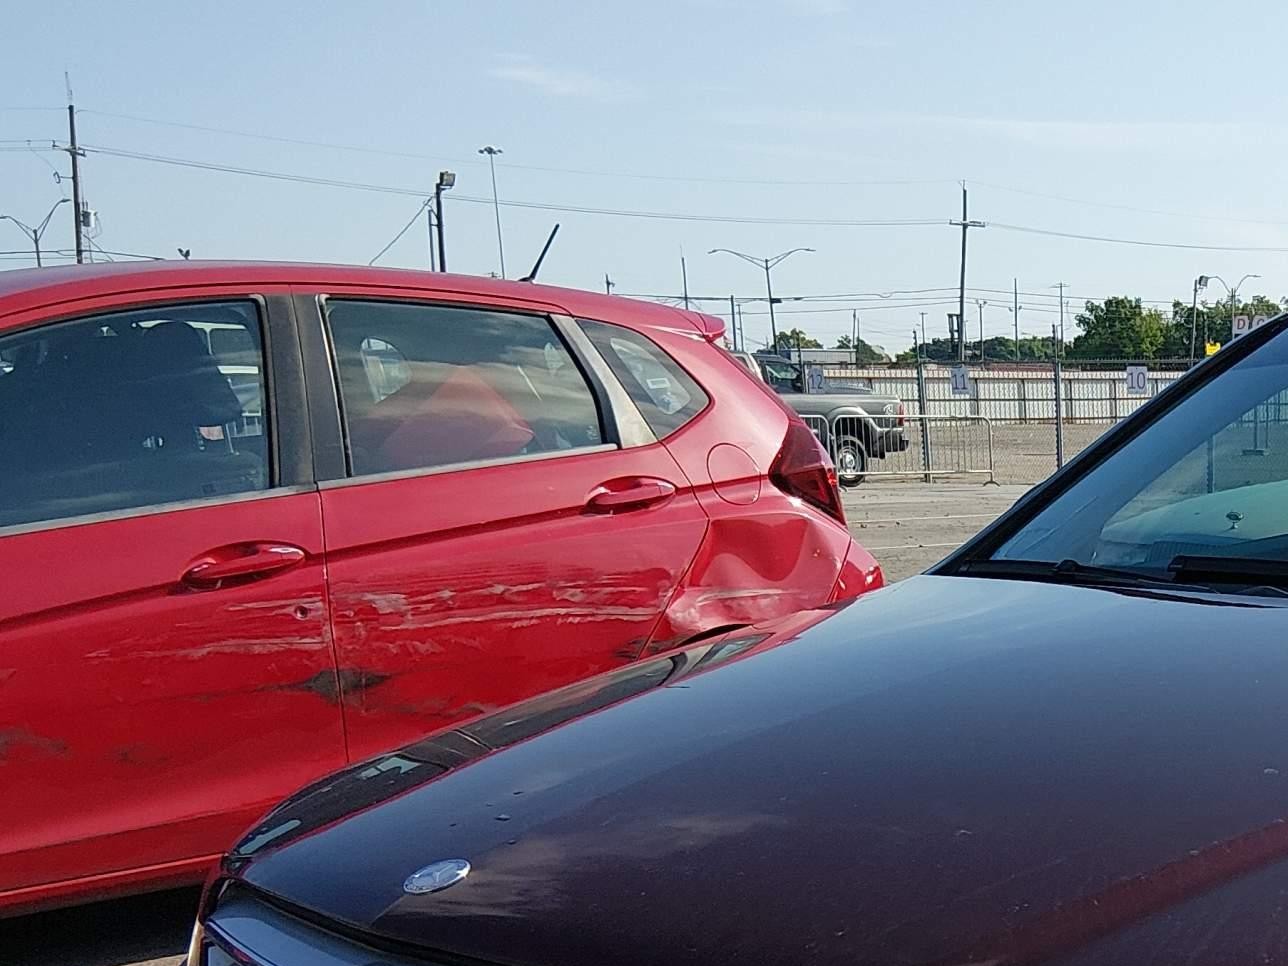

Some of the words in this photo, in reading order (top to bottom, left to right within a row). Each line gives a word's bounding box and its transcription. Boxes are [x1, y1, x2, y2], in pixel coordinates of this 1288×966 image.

[1237, 318, 1246, 330] D
[810, 374, 823, 390] 12
[952, 375, 968, 390] 11
[1129, 371, 1146, 390] 10
